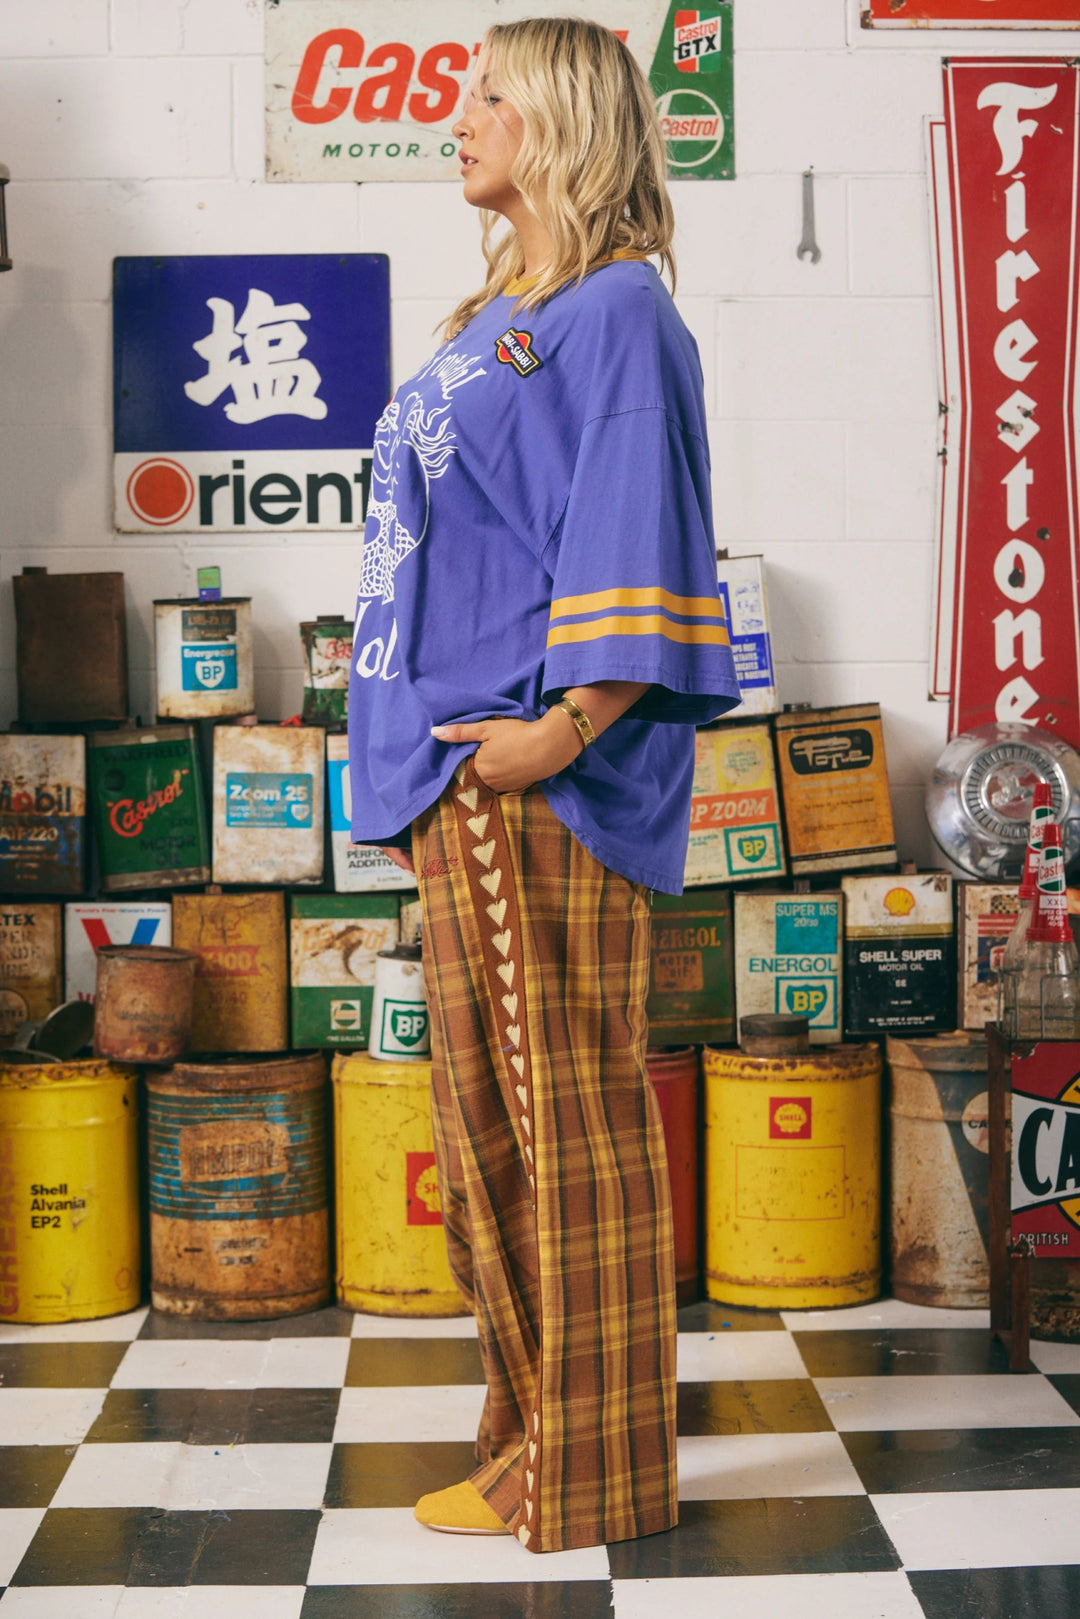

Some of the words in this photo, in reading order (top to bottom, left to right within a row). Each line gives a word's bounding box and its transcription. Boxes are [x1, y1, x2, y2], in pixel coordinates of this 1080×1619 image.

[677, 20, 718, 42] Castrol
[677, 34, 717, 60] GTX
[290, 28, 482, 125] Cas
[322, 143, 419, 158] MOTOR
[184, 288, 328, 425] 塩
[976, 82, 1058, 727] Firestone
[324, 640, 354, 661] Cas
[201, 665, 222, 680] BP
[230, 785, 281, 800] Zoom
[285, 785, 308, 801] 25
[710, 796, 770, 821] ZOOM
[742, 839, 765, 857] BP
[776, 904, 815, 917] SUPER
[819, 904, 838, 916] MS
[0, 914, 35, 926] TEX
[859, 950, 898, 963] SHELL
[901, 949, 942, 962] SUPER
[749, 957, 838, 973] ENERGOL
[878, 963, 907, 972] MOTOR
[910, 963, 924, 971] OIL
[792, 991, 824, 1012] BP
[396, 1015, 425, 1037] BP
[779, 1113, 802, 1122] SHELL
[30, 1184, 68, 1196] Shell
[30, 1197, 86, 1211] Alvania
[31, 1215, 62, 1229] EP2
